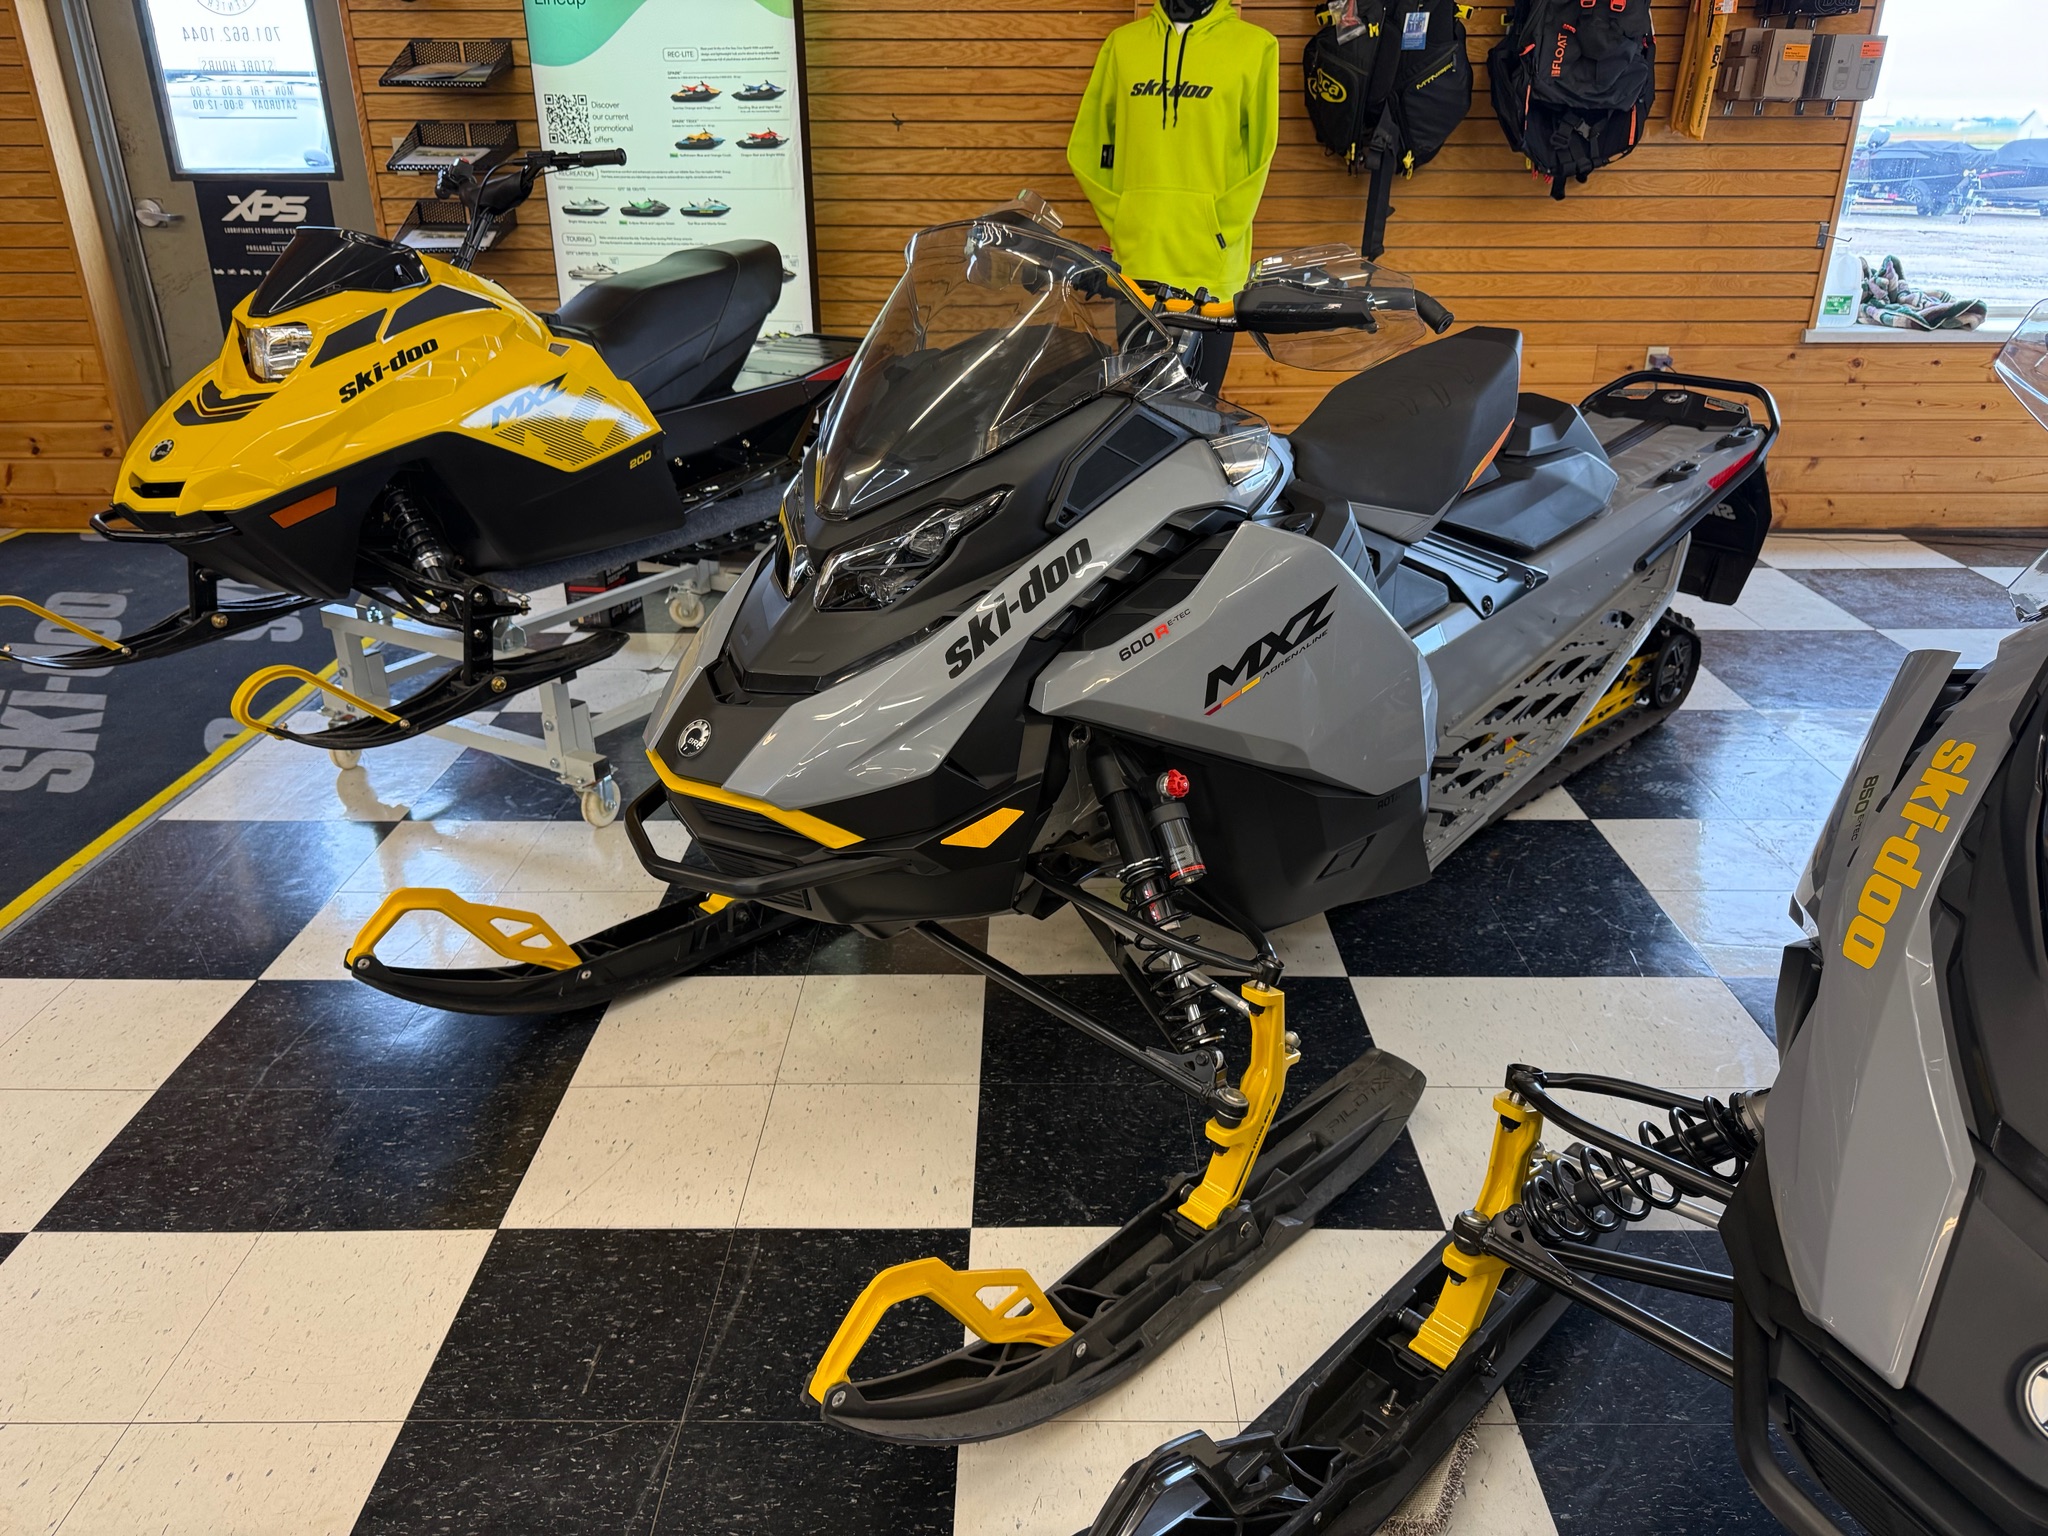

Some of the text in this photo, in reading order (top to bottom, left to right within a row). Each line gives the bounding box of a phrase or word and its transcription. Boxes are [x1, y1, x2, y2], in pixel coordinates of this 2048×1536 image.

[591, 101, 620, 109] Discover
[1130, 78, 1213, 99] ski-doo
[593, 125, 634, 133] promotional
[604, 113, 629, 121] current
[594, 136, 614, 144] offers
[221, 189, 310, 222] XPS
[339, 338, 439, 404] ski-doo
[491, 372, 568, 429] MXZ
[629, 450, 652, 470] 200
[944, 538, 1093, 680] ski-doo
[1167, 608, 1191, 627] E-TEC
[1204, 584, 1339, 709] MXZ
[1262, 629, 1329, 679] ADRENALINE
[1851, 774, 1879, 841] 850 E-TEC
[1843, 739, 1977, 969] ski-doo
